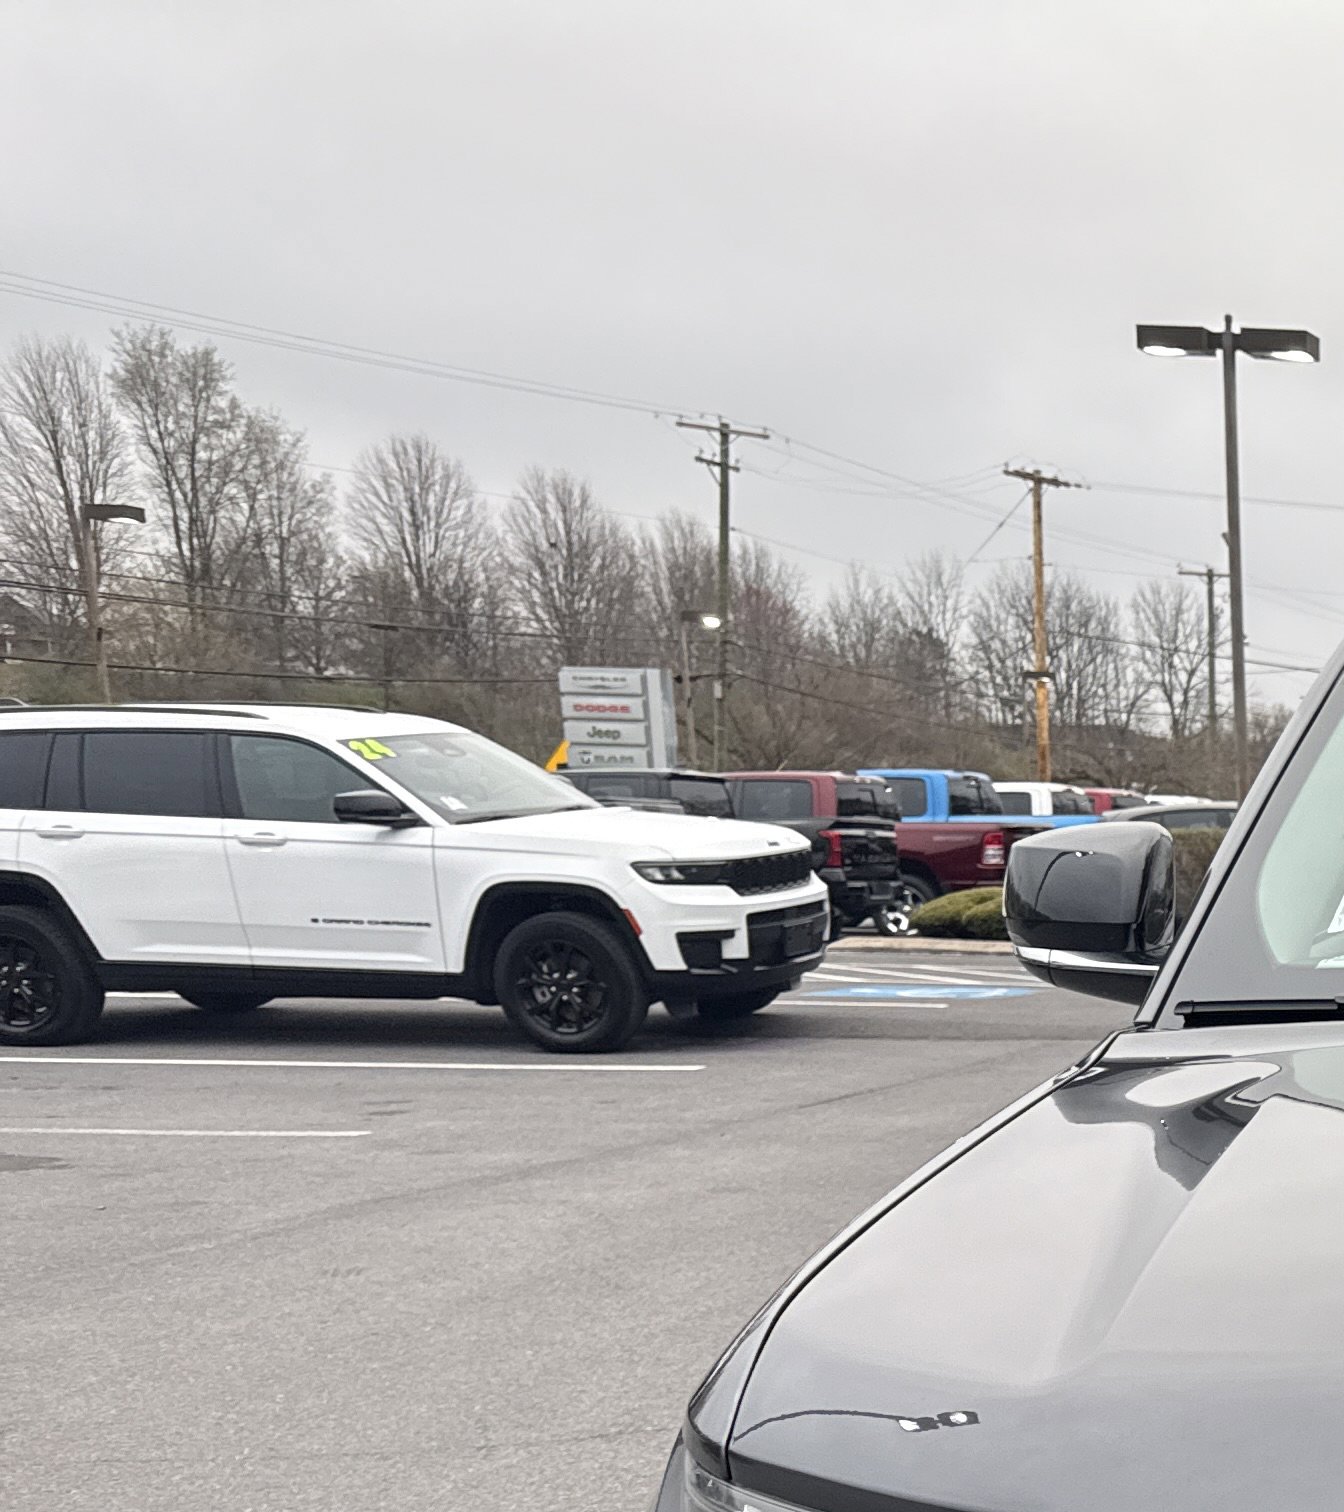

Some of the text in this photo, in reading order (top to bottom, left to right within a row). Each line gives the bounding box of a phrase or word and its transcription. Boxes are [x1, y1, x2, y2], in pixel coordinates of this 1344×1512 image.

[573, 703, 631, 713] DODGE
[586, 725, 621, 740] Jeep
[348, 738, 397, 760] 24
[594, 755, 634, 764] RAM
